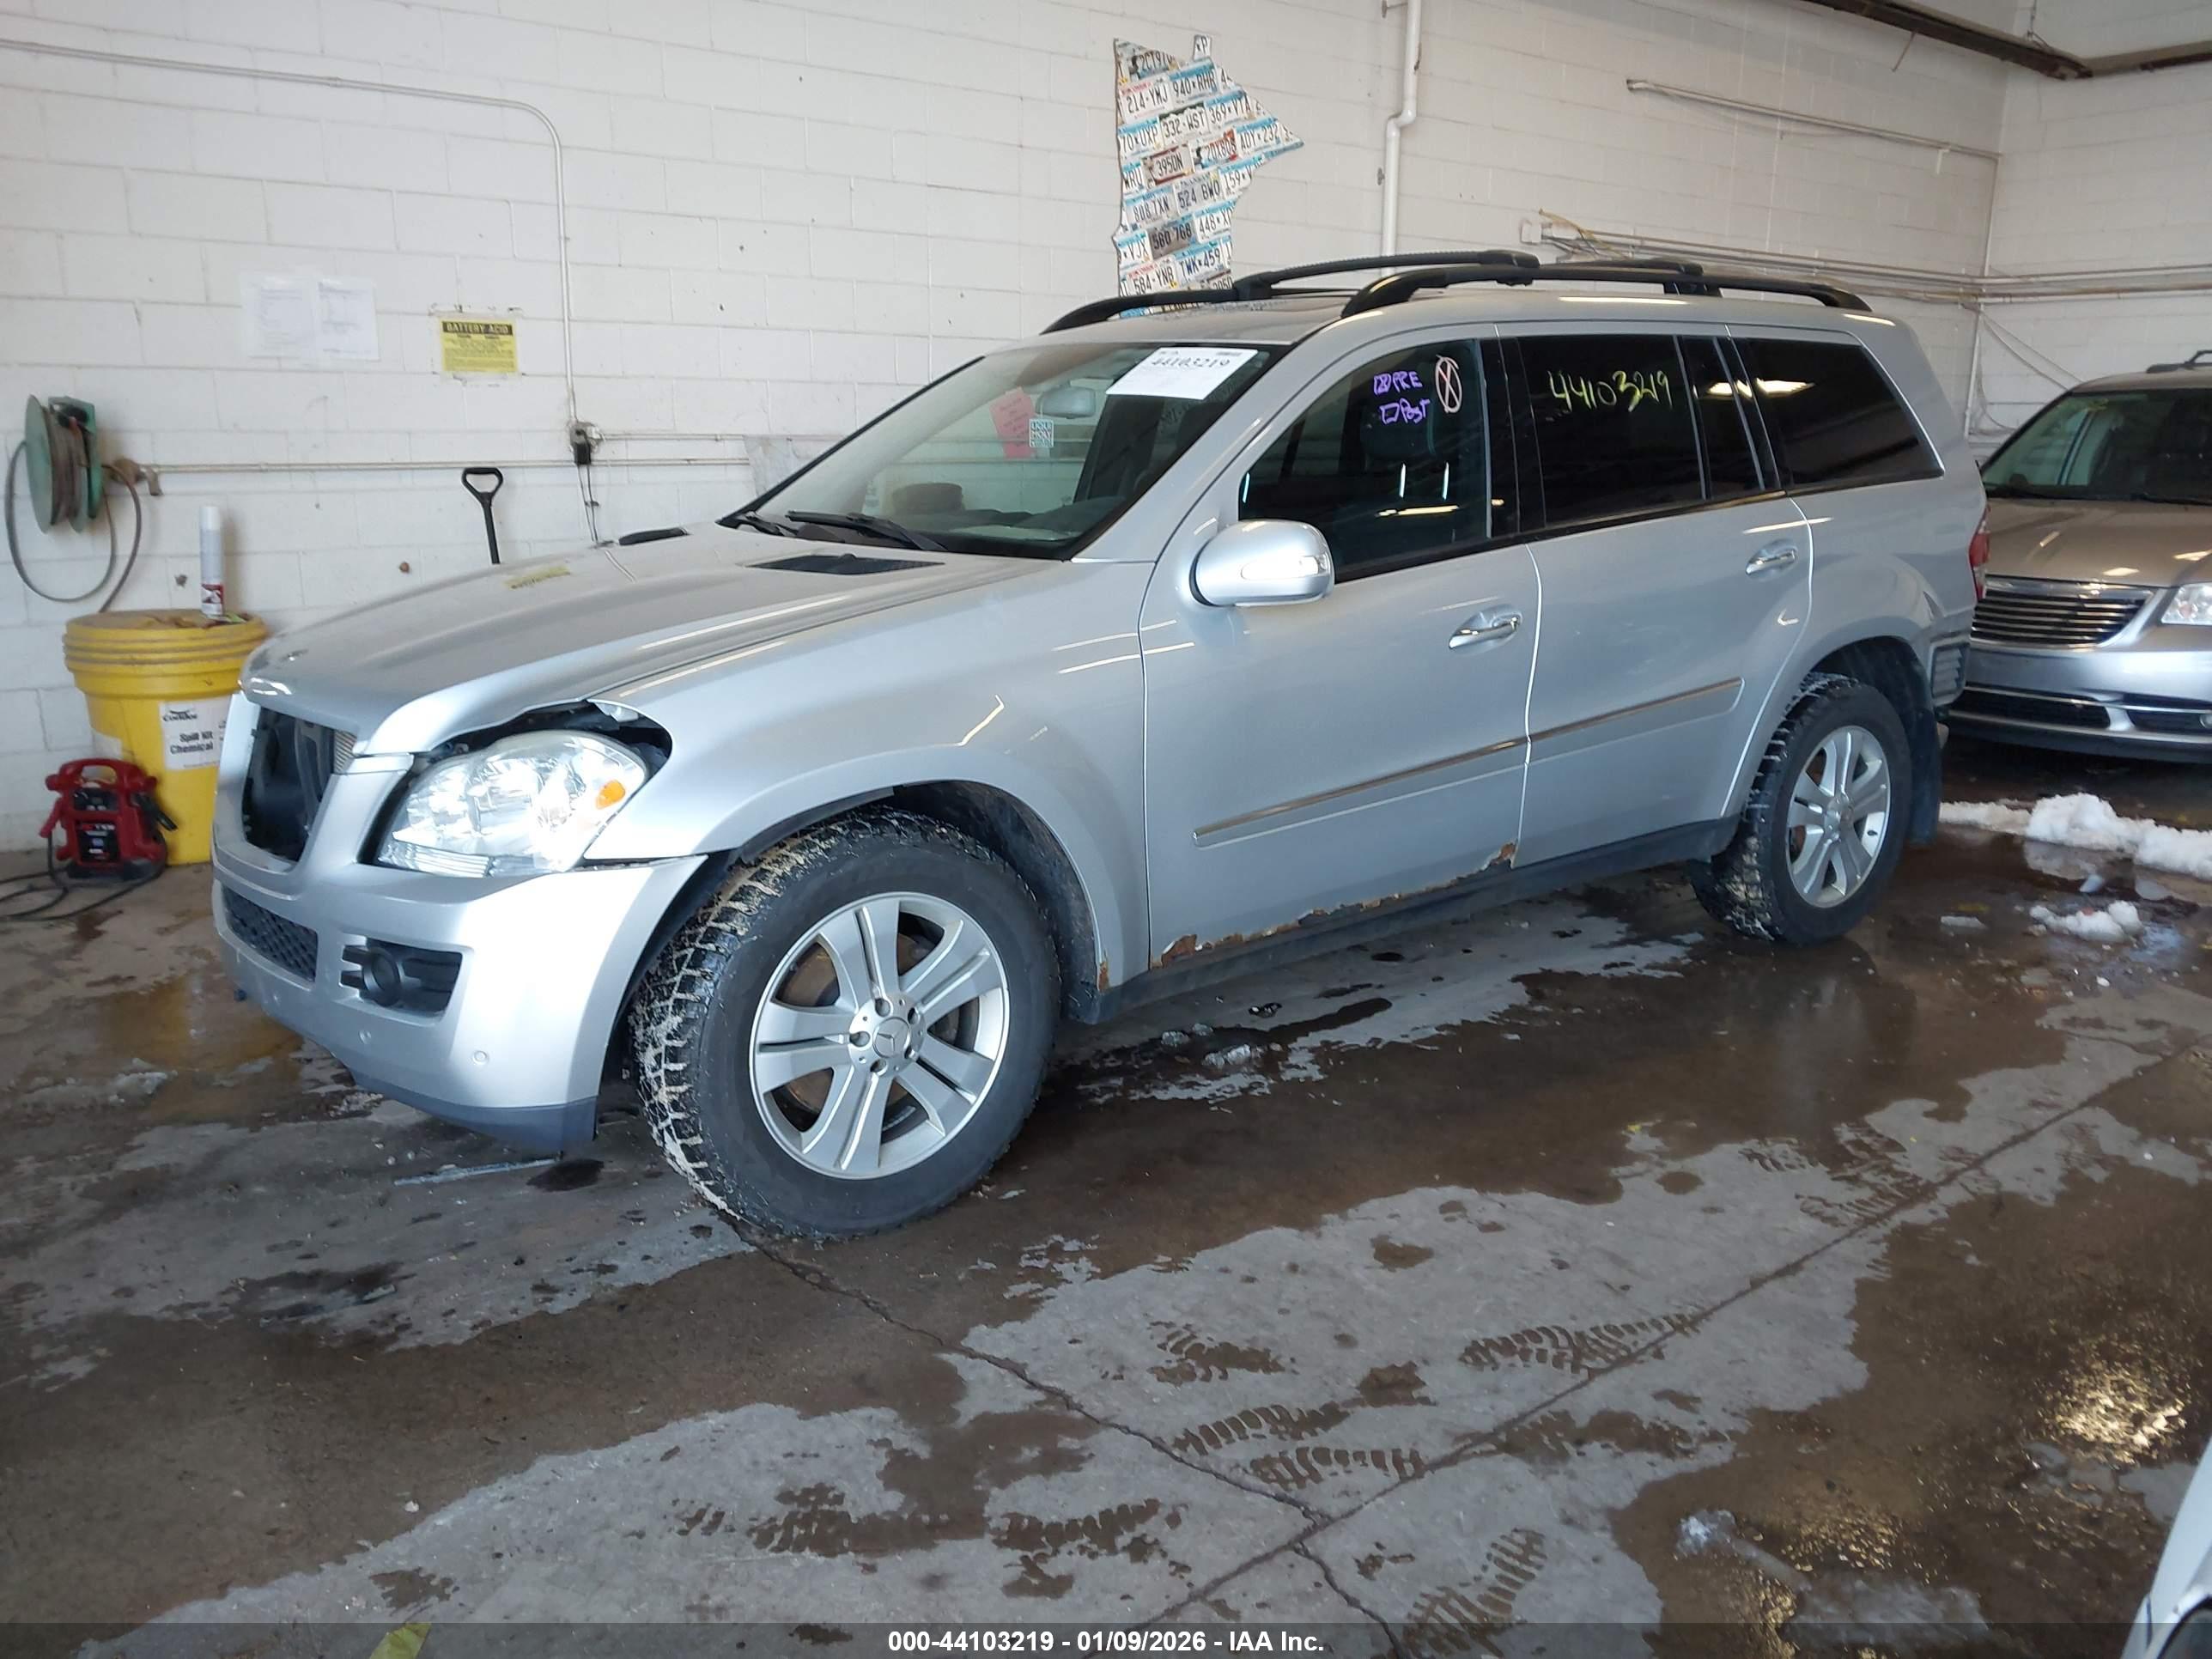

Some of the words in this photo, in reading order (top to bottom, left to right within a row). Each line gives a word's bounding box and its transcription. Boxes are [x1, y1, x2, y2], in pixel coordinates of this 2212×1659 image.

[446, 322, 483, 334] BATTERY
[488, 324, 510, 335] ACID
[1548, 369, 1673, 413] 44103219
[170, 741, 213, 754] Chemical
